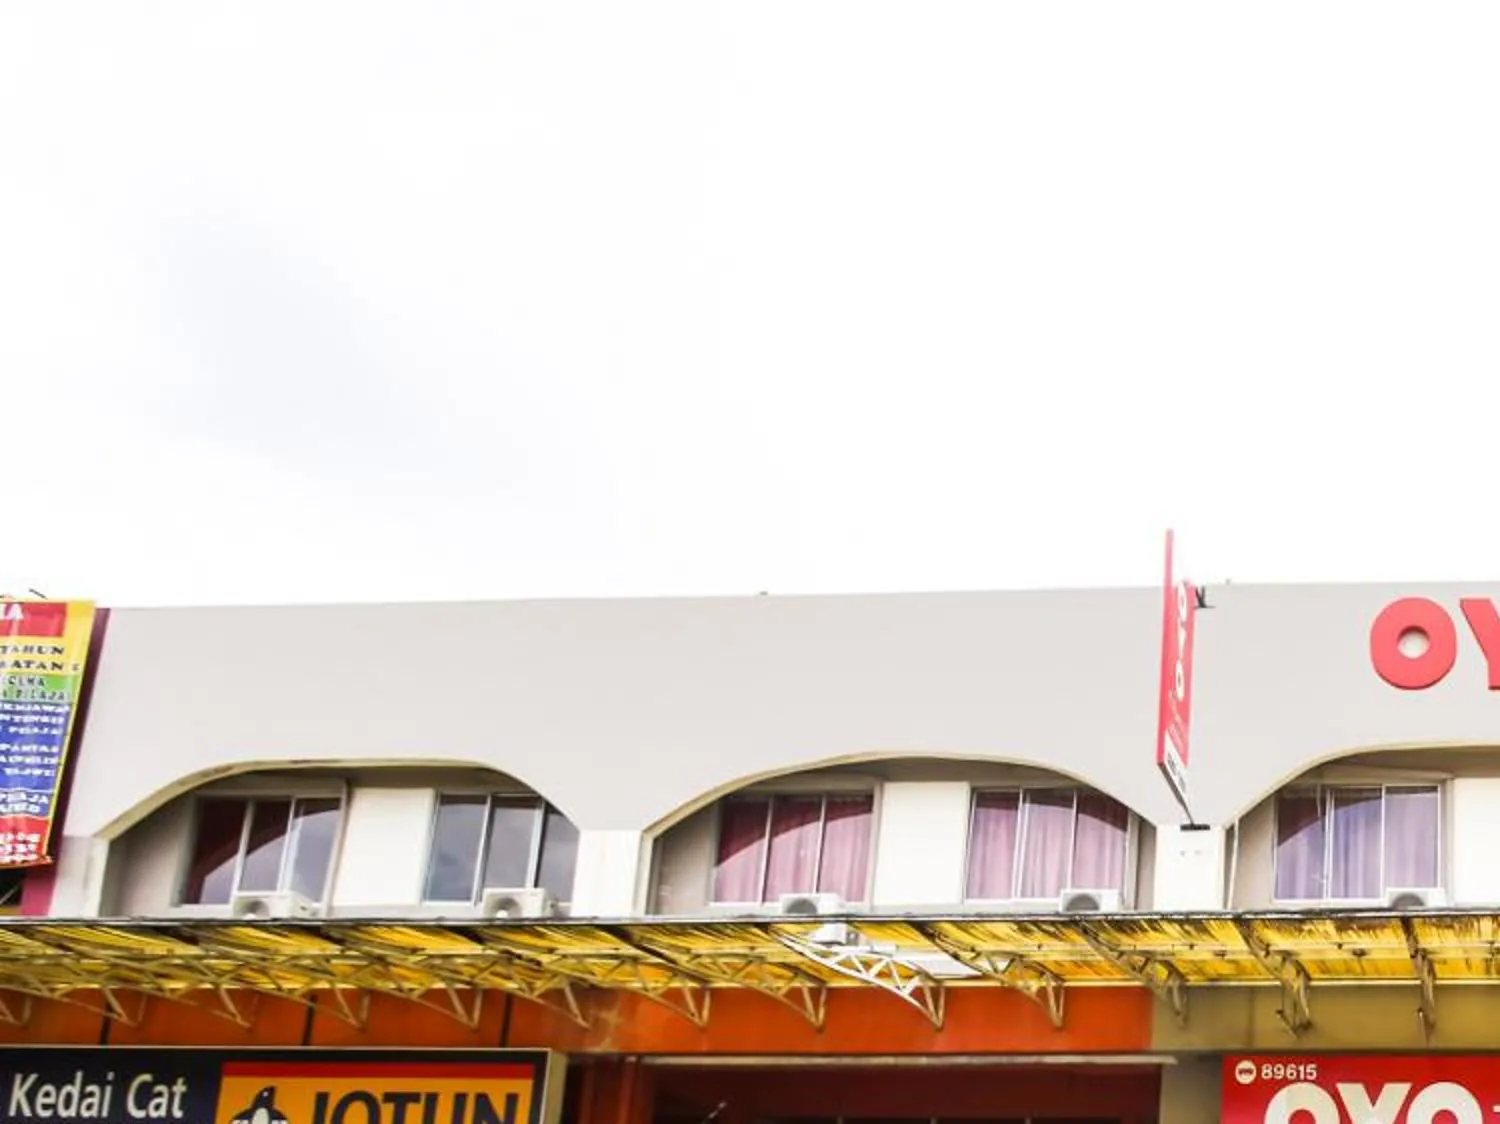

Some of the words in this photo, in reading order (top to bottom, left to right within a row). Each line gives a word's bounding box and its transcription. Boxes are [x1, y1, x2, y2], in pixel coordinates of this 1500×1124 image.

[1261, 1063, 1318, 1081] 89615
[8, 1071, 115, 1118] Kedai
[127, 1073, 188, 1119] Cat
